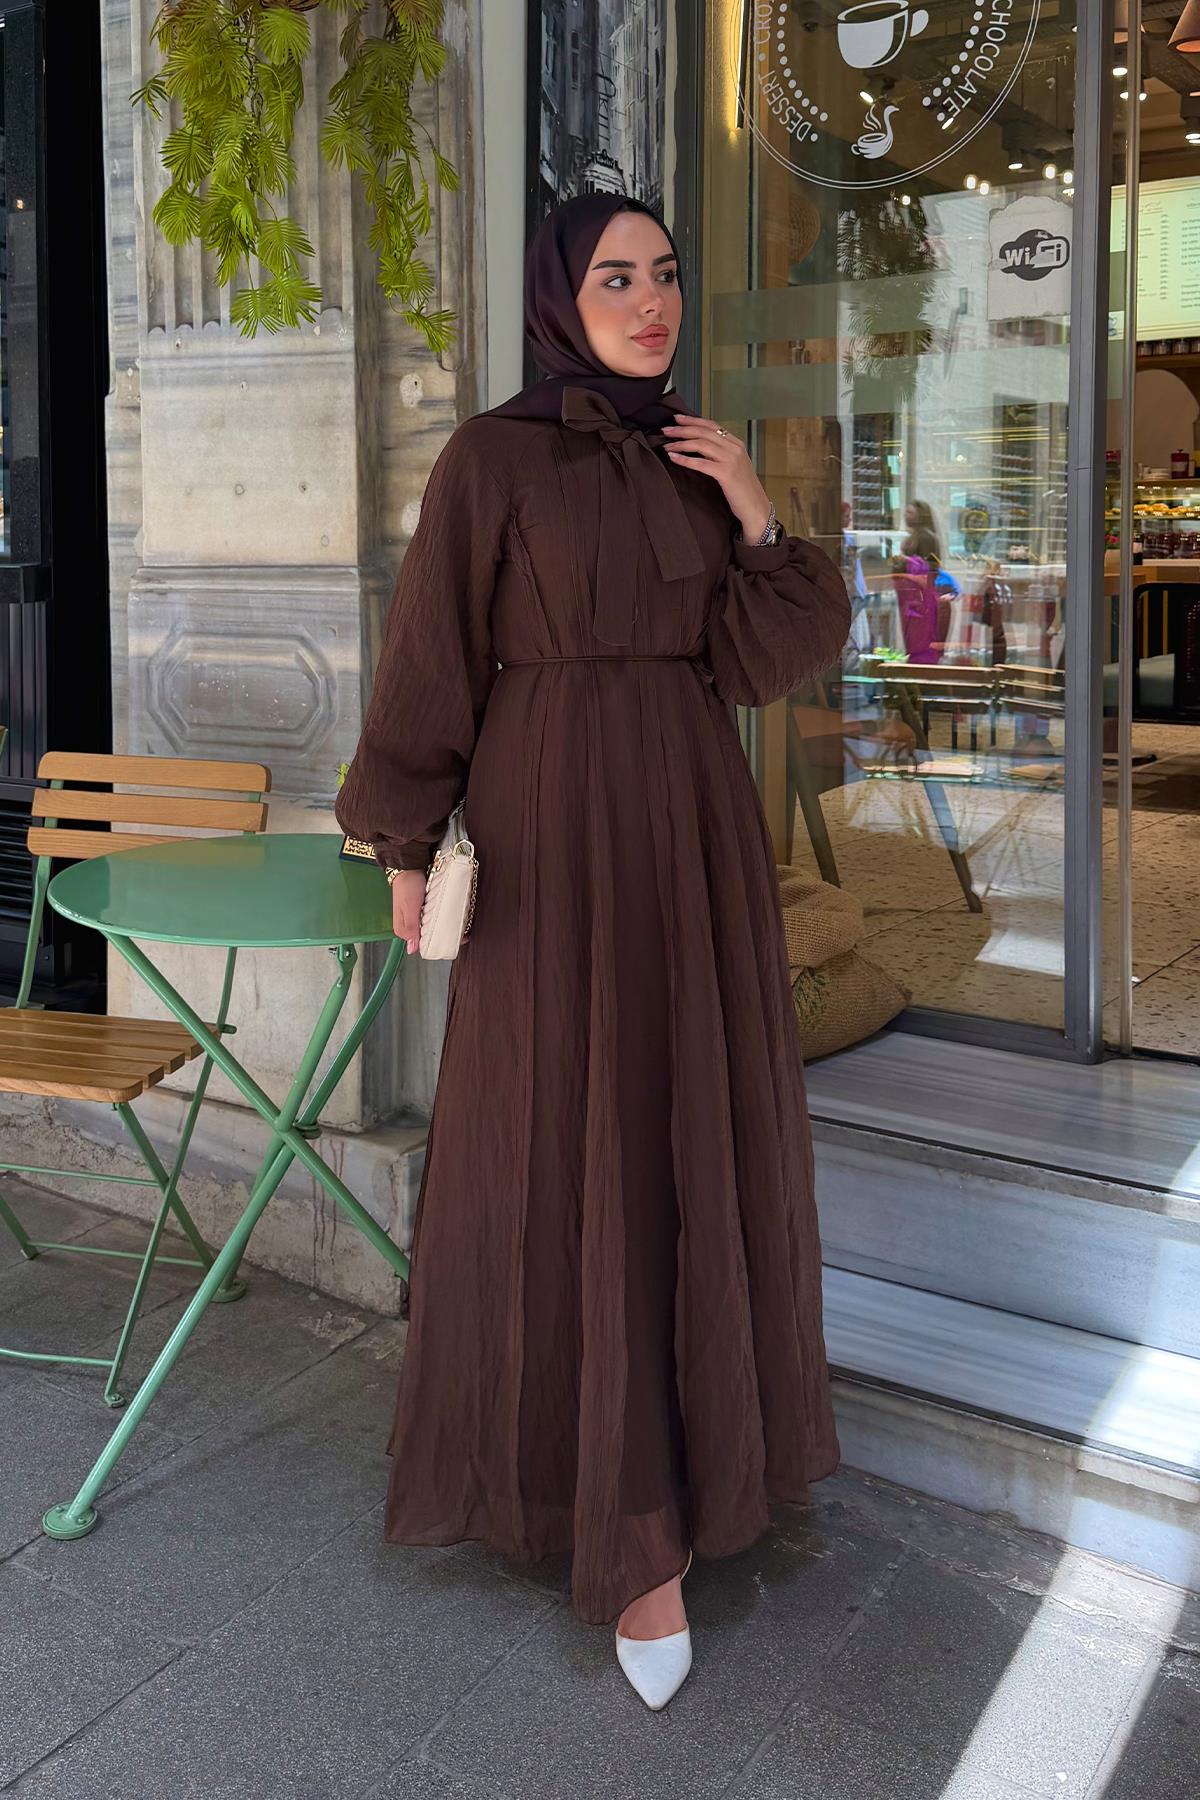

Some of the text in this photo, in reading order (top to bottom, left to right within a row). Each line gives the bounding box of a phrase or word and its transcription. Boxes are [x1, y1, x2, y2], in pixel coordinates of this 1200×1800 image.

[753, 0, 775, 45] CRO
[943, 0, 1013, 118] CHOCOLATE
[758, 70, 812, 142] DESSERT
